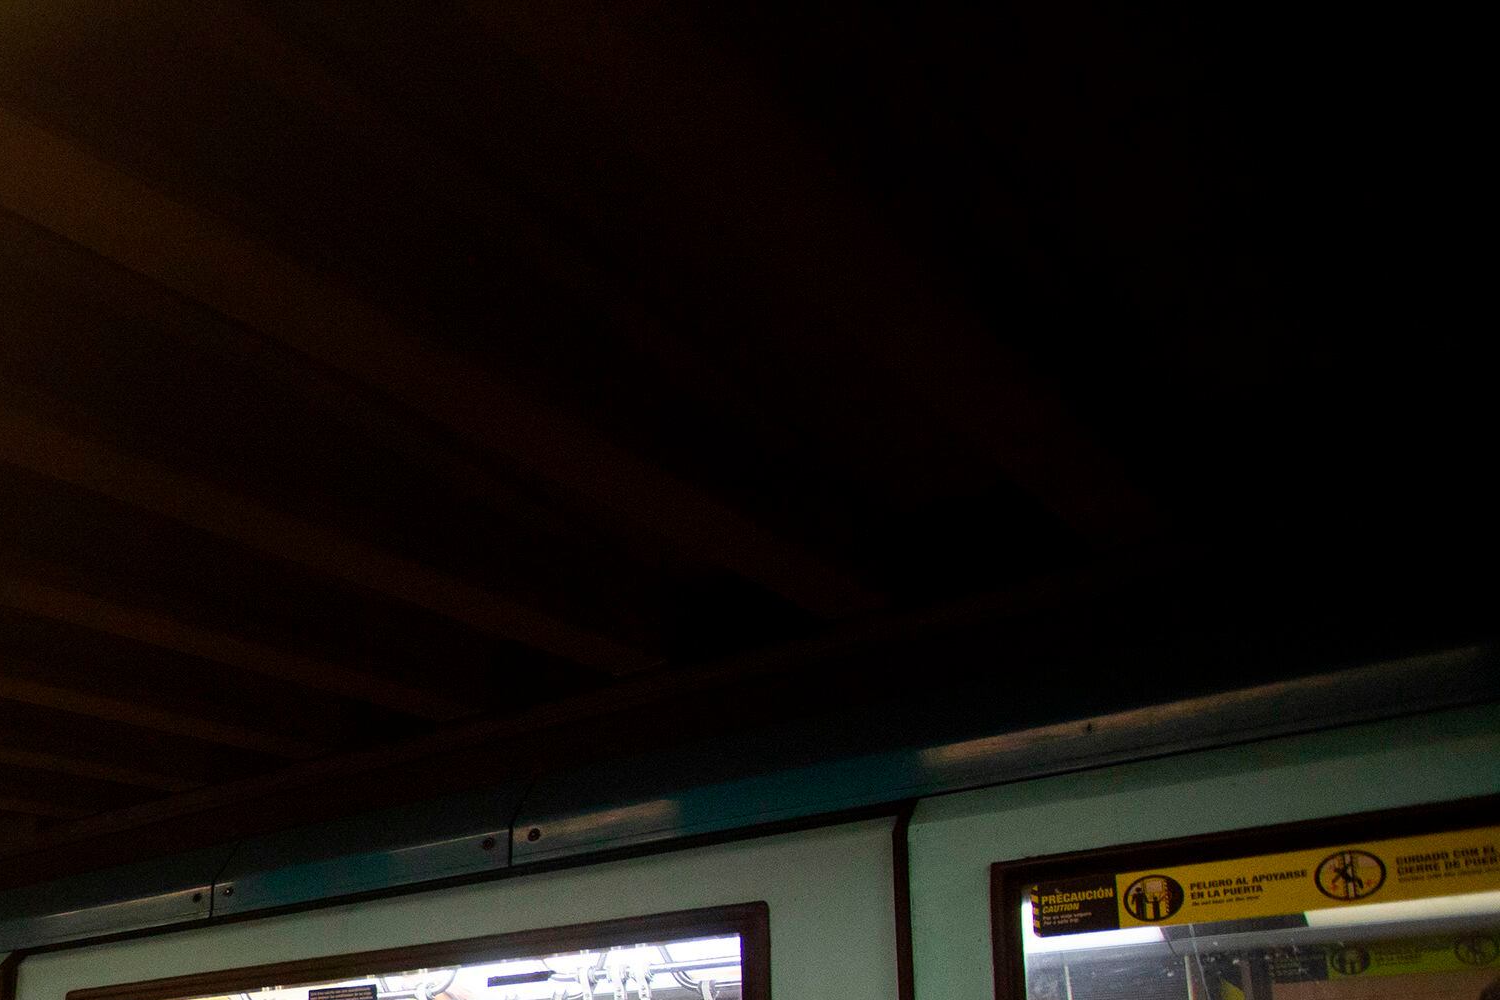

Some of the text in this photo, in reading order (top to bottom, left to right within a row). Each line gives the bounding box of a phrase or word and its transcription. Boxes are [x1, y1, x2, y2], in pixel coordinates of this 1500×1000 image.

[1190, 869, 1308, 891] PELIGRO AL APOYARSE
[1041, 887, 1114, 904] PRECAUCIÓN
[1191, 884, 1264, 900] EN LA PUERTA
[1042, 902, 1080, 914] CAUTION
